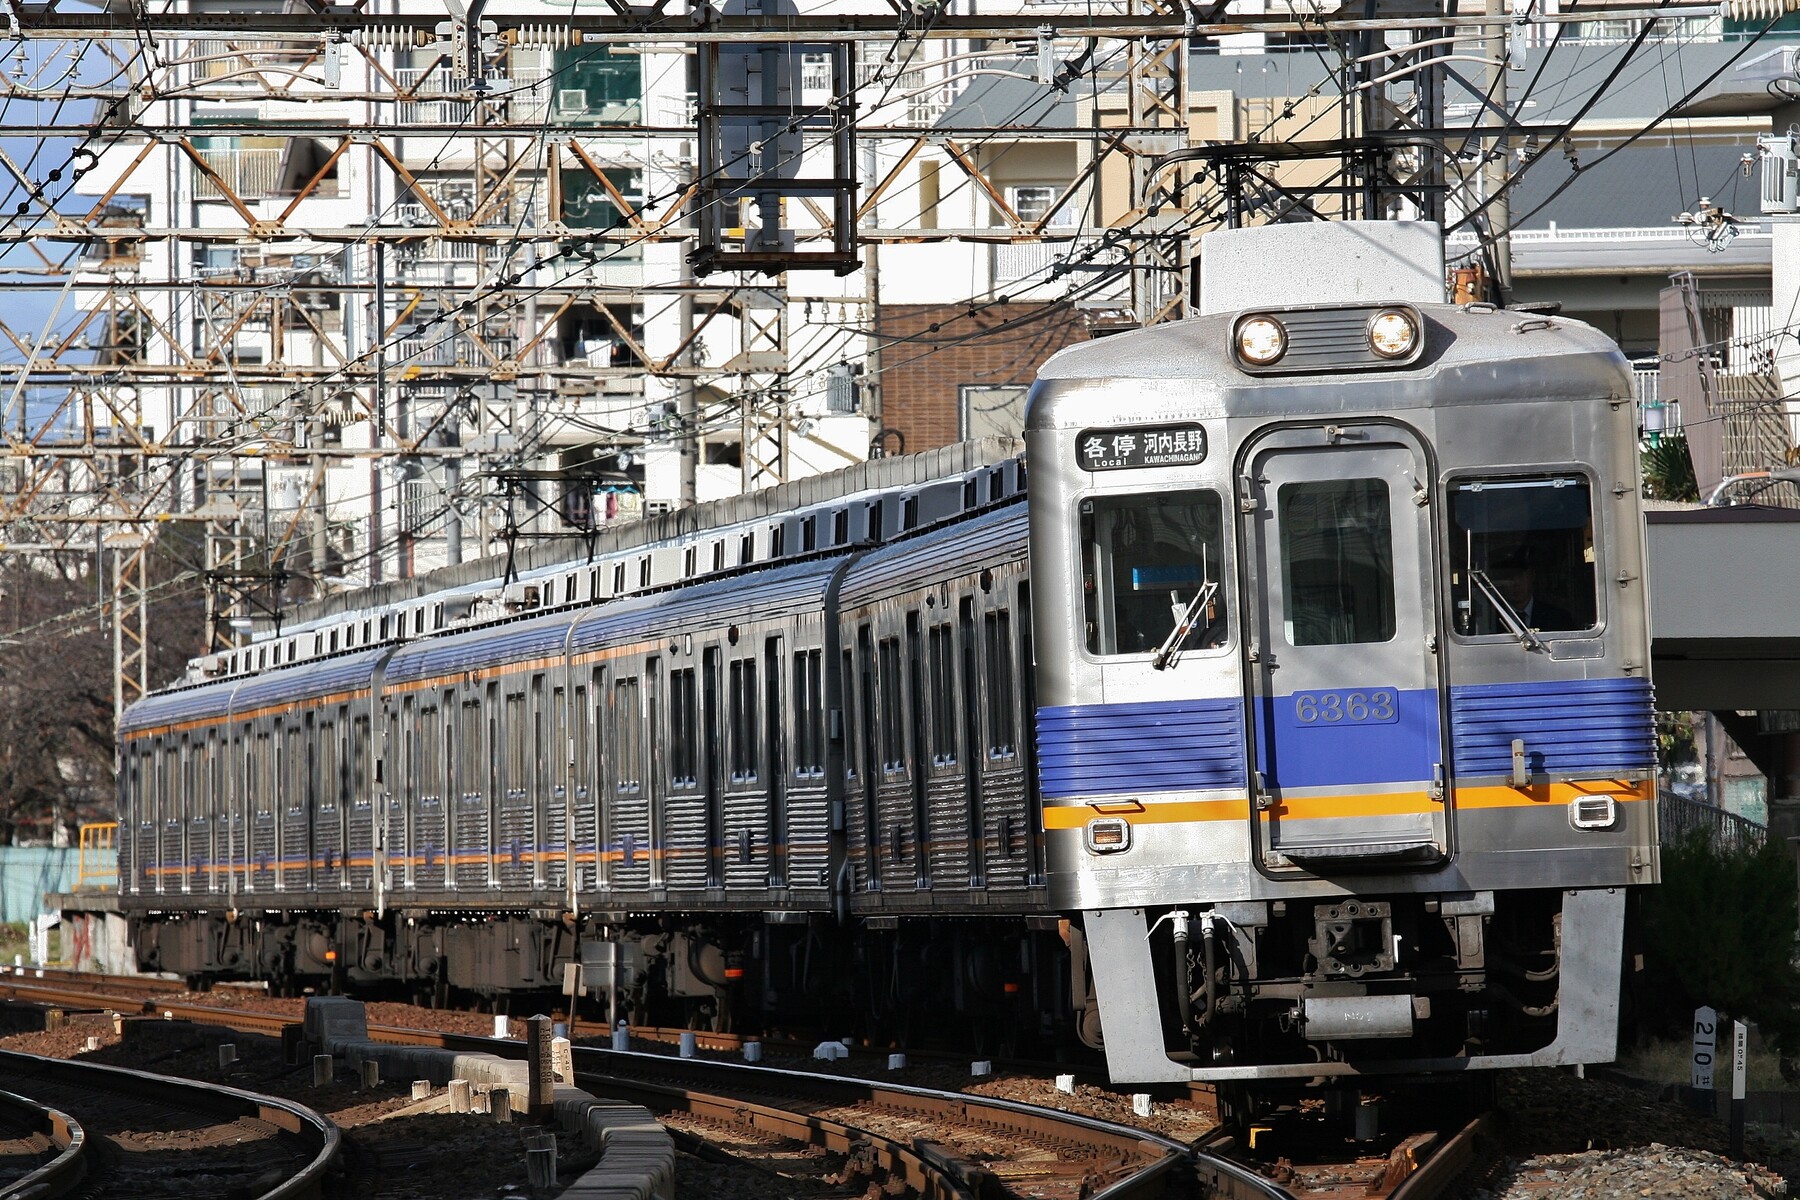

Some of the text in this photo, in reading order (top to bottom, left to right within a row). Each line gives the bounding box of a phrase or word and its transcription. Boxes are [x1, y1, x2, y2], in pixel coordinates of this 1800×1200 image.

[1084, 430, 1203, 458] 各停 河内長野
[1094, 457, 1127, 467] Local
[1296, 691, 1395, 723] 6363
